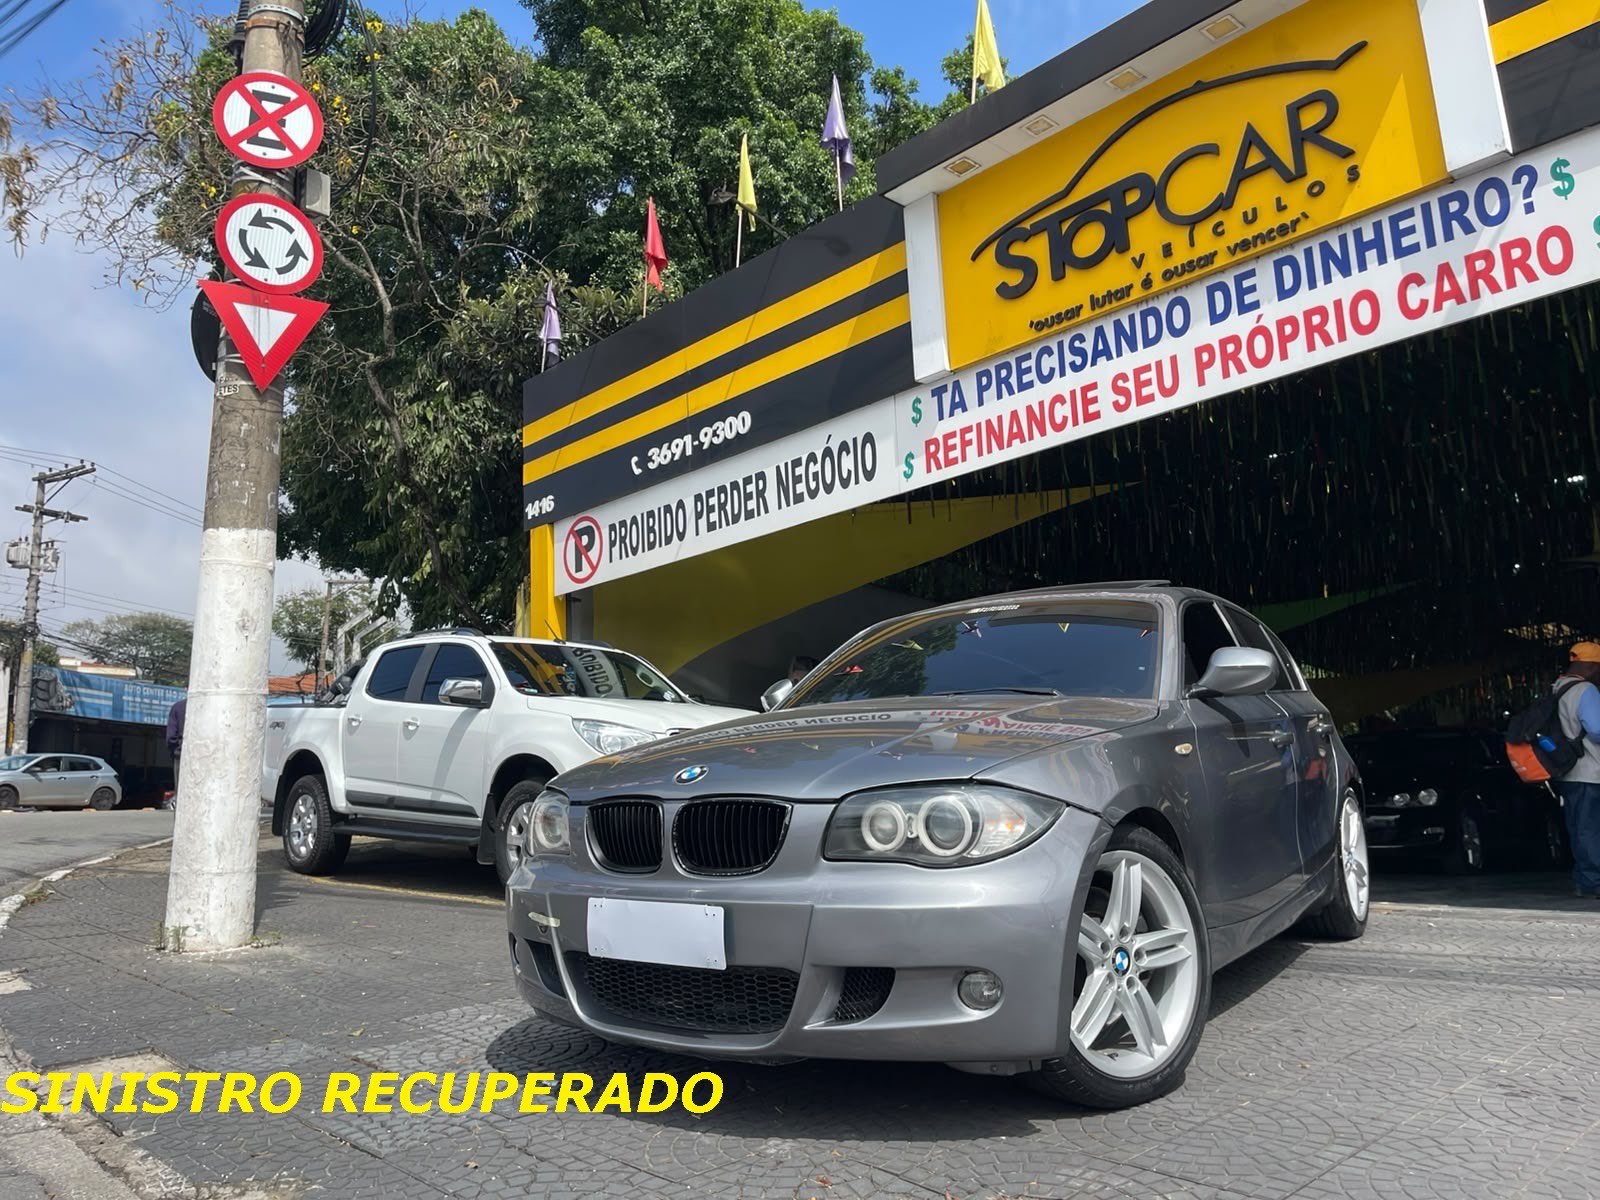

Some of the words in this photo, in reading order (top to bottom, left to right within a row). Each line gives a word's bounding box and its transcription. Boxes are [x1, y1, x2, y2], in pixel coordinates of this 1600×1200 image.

[995, 89, 1355, 300] STOPCAR
[931, 379, 968, 422] TA
[975, 295, 1191, 408] PRECISANDO
[1206, 268, 1261, 326] DE
[1273, 164, 1539, 302] DINHEIRO?
[1090, 282, 1134, 310] lutar
[1141, 272, 1153, 290] é
[1162, 248, 1217, 282] ousar
[924, 382, 1101, 474] REFINANCIE
[1111, 354, 1180, 413] SEU
[1194, 289, 1381, 387] PRÓPRIO
[1397, 225, 1574, 320] CARRO
[608, 498, 687, 564] PROIBIDO
[694, 470, 769, 536] PERDER
[775, 431, 877, 508] NEGÓCIO
[647, 410, 752, 470] 3691-9300
[525, 495, 555, 520] 1416
